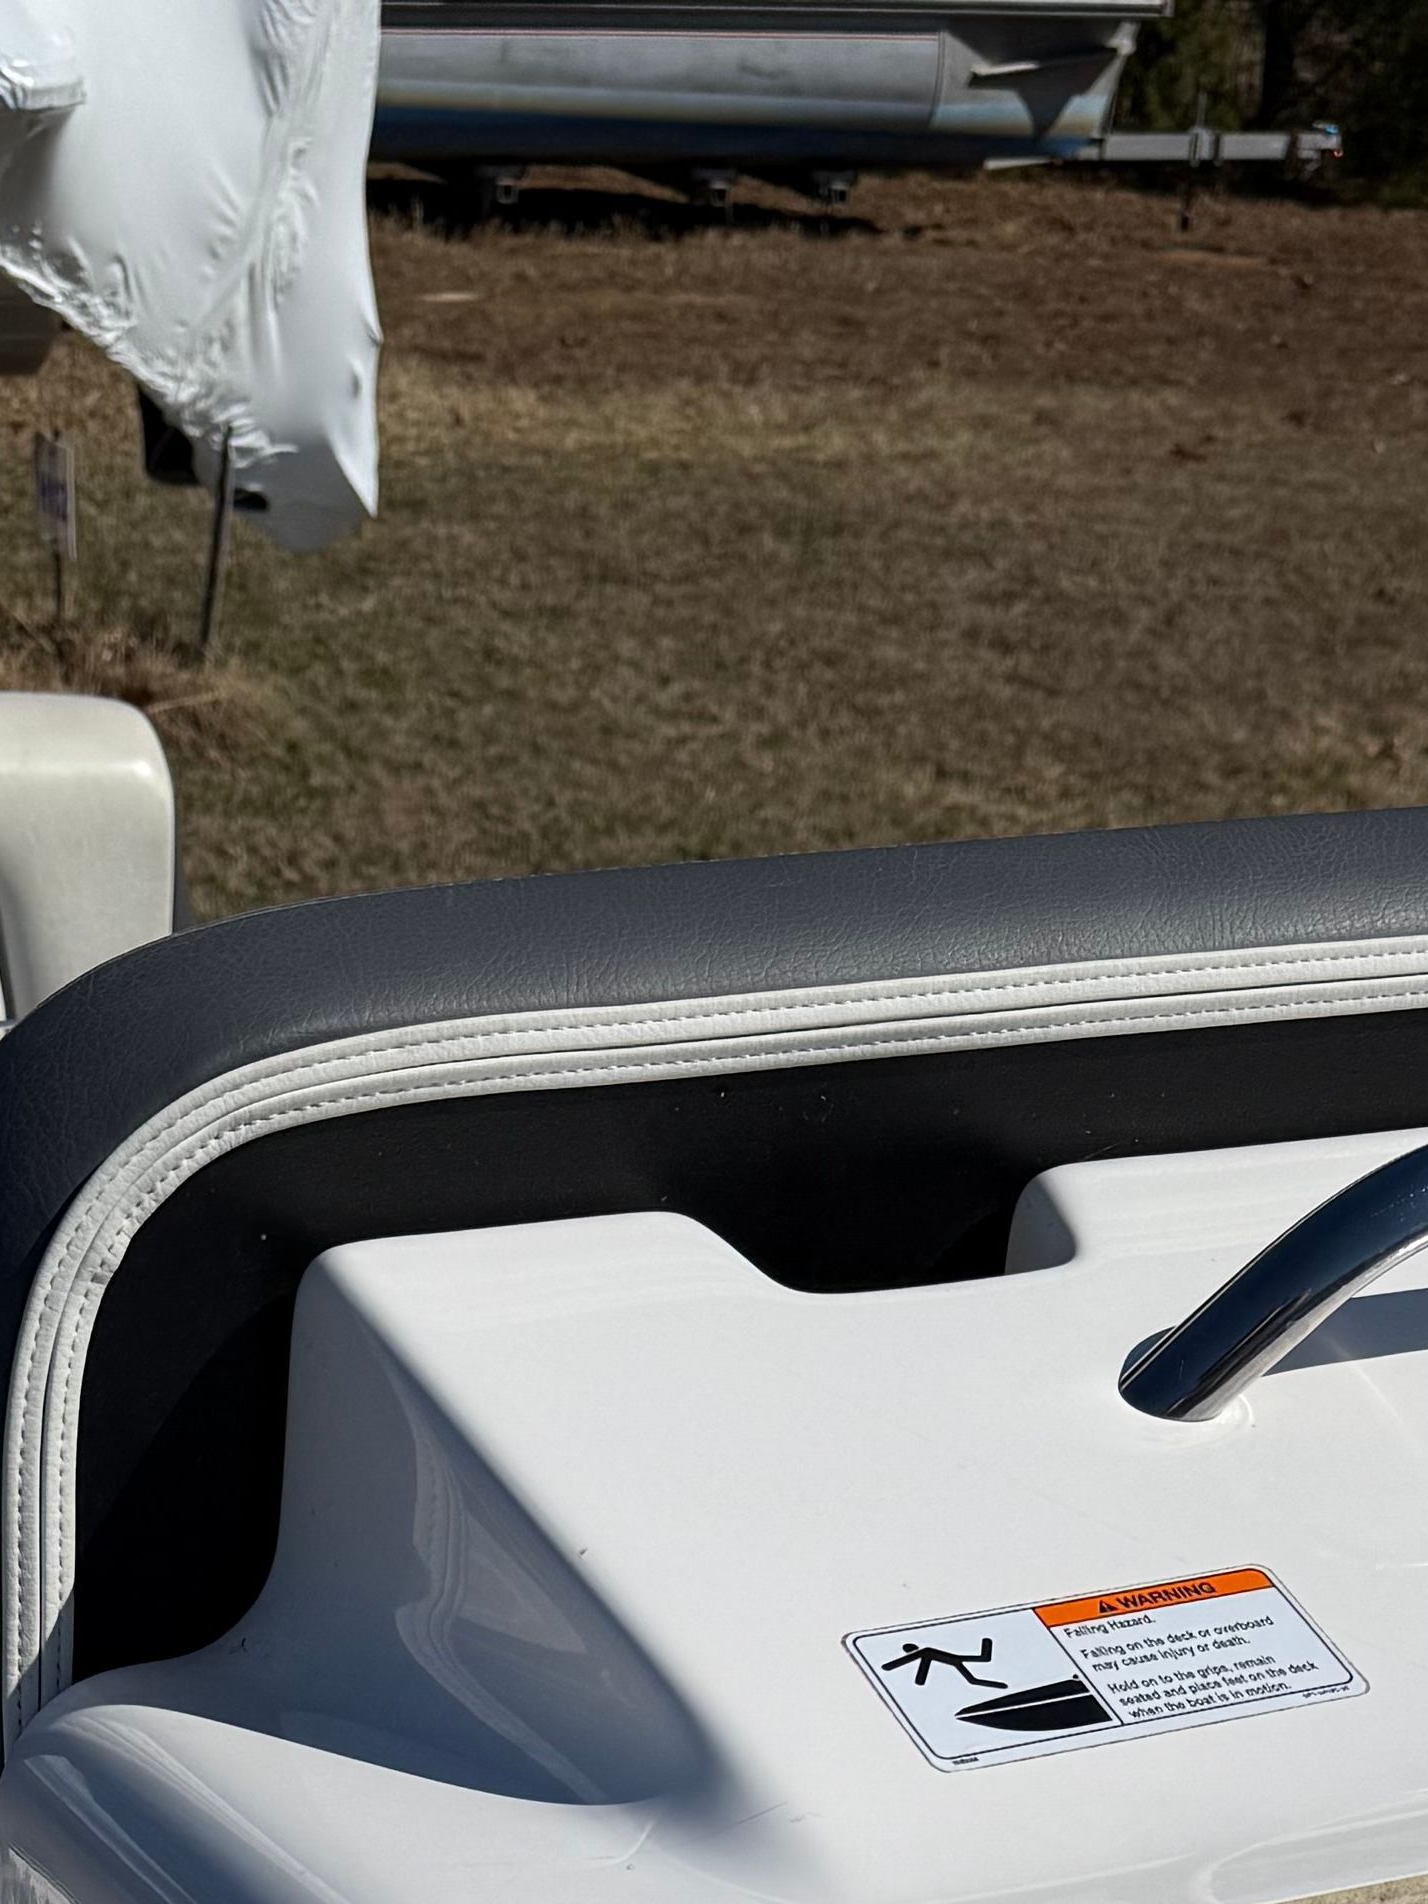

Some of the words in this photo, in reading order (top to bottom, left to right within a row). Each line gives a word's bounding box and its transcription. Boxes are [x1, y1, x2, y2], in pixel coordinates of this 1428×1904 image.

[1116, 1582, 1216, 1608] WARNING
[1064, 1624, 1109, 1638] Falling
[1107, 1615, 1156, 1630] Hazard.
[1080, 1646, 1126, 1659] Falling
[1126, 1642, 1143, 1650] on
[1143, 1638, 1165, 1647] the
[1167, 1631, 1197, 1643] deck
[1198, 1629, 1211, 1637] or
[1214, 1616, 1274, 1634] overboard
[1092, 1661, 1119, 1671] may
[1122, 1653, 1158, 1666] cause
[1158, 1646, 1195, 1660] injury
[1197, 1644, 1209, 1652] or
[1212, 1636, 1250, 1649] death.
[1107, 1680, 1139, 1694] Hold
[1141, 1679, 1158, 1687] on
[1158, 1675, 1173, 1684] to
[1173, 1671, 1196, 1681] the
[1197, 1665, 1233, 1678] grips,
[1233, 1656, 1276, 1670] remain
[1119, 1690, 1161, 1706] seated
[1163, 1685, 1187, 1697] and
[1188, 1681, 1222, 1695] place
[1222, 1675, 1248, 1686] feet
[1249, 1673, 1265, 1681] on
[1265, 1668, 1287, 1678] the
[1288, 1661, 1319, 1673] deck
[1129, 1706, 1163, 1718] when
[1164, 1702, 1186, 1711] the
[1186, 1695, 1216, 1707] boat
[1215, 1692, 1229, 1702] is
[1229, 1690, 1244, 1699] in
[1245, 1683, 1291, 1696] motion.
